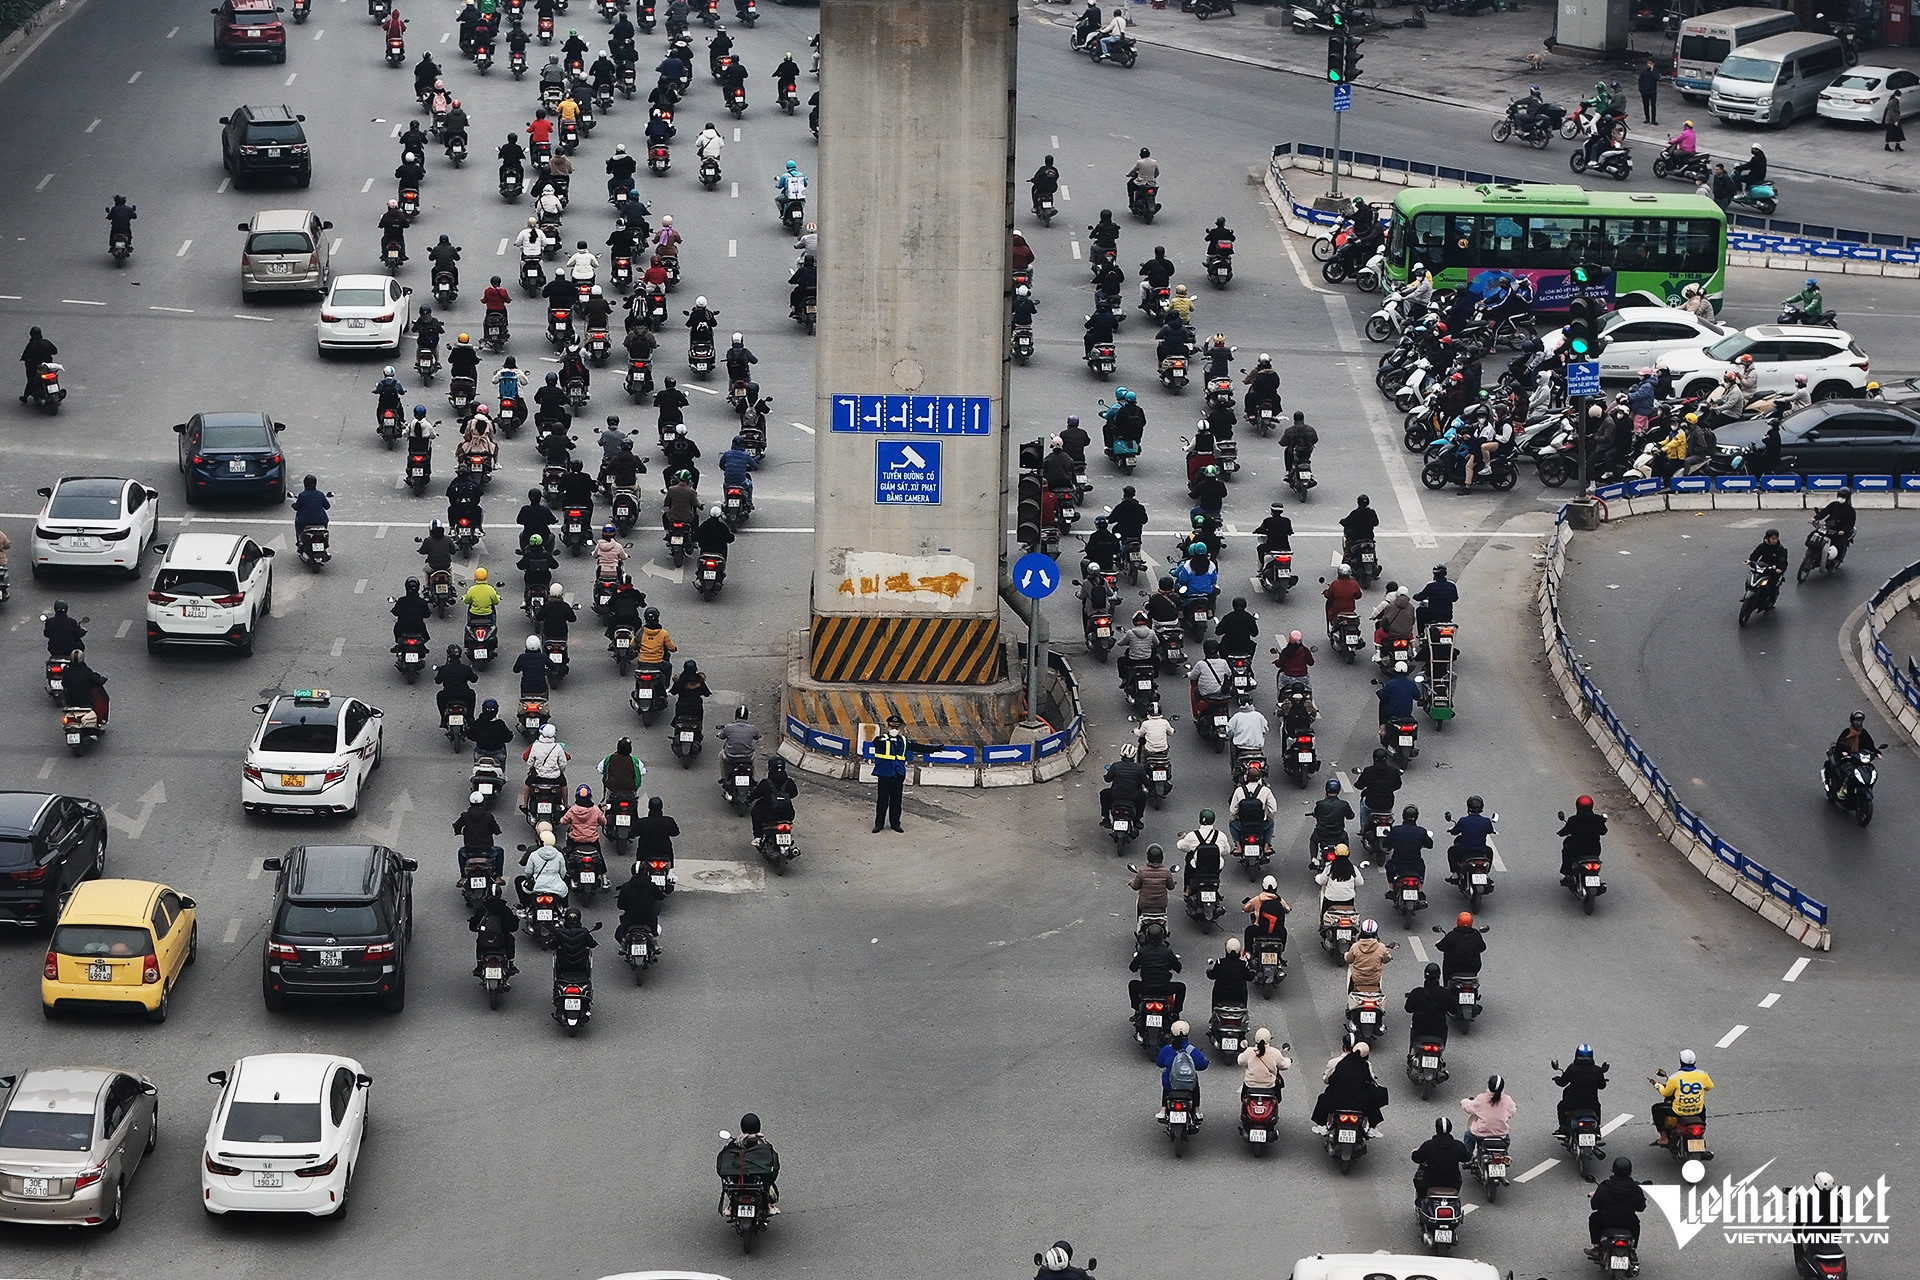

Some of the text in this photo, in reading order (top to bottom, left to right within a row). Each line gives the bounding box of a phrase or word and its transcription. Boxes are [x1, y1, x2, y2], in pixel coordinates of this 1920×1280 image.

[882, 469, 935, 481] TUYẾN ĐƯỜNG CÓ
[880, 481, 896, 491] GIÁM
[921, 484, 936, 493] PHẠT
[904, 494, 930, 502] CAMERA
[1680, 1079, 1702, 1094] be
[1679, 1095, 1701, 1105] Food
[30, 1179, 42, 1187] 30E
